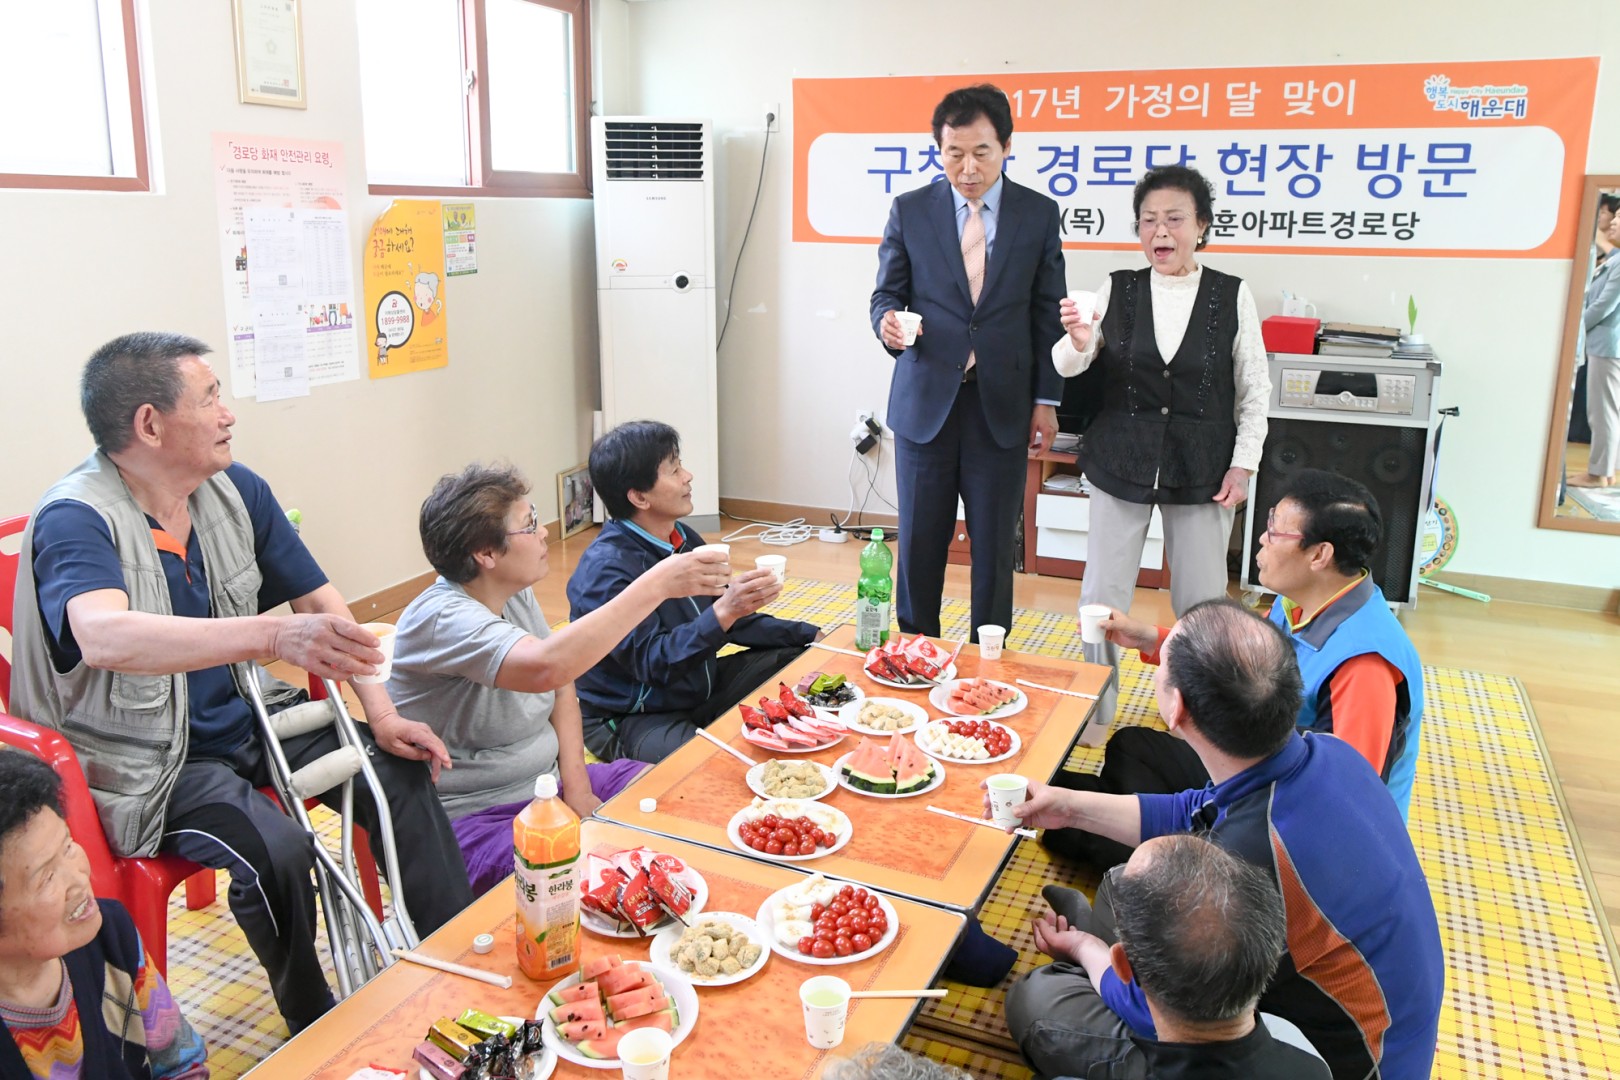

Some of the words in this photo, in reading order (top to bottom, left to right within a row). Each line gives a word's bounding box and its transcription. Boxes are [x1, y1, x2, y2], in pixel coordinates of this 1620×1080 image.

[1006, 85, 1080, 119] 17년
[1104, 82, 1208, 119] 가정의
[1226, 81, 1261, 117] 달
[1283, 79, 1356, 117] 맞이
[1426, 86, 1448, 99] 행복
[1485, 86, 1526, 94] Haeundae
[1436, 98, 1458, 109] 도시
[1460, 99, 1526, 118] 해운대
[261, 148, 278, 161] 화재
[280, 149, 312, 164] 안전관리
[1217, 142, 1333, 199] 현장
[1356, 142, 1477, 199] 방문
[1211, 209, 1421, 241] 훈아파트경로당
[548, 879, 574, 896] 한라봉
